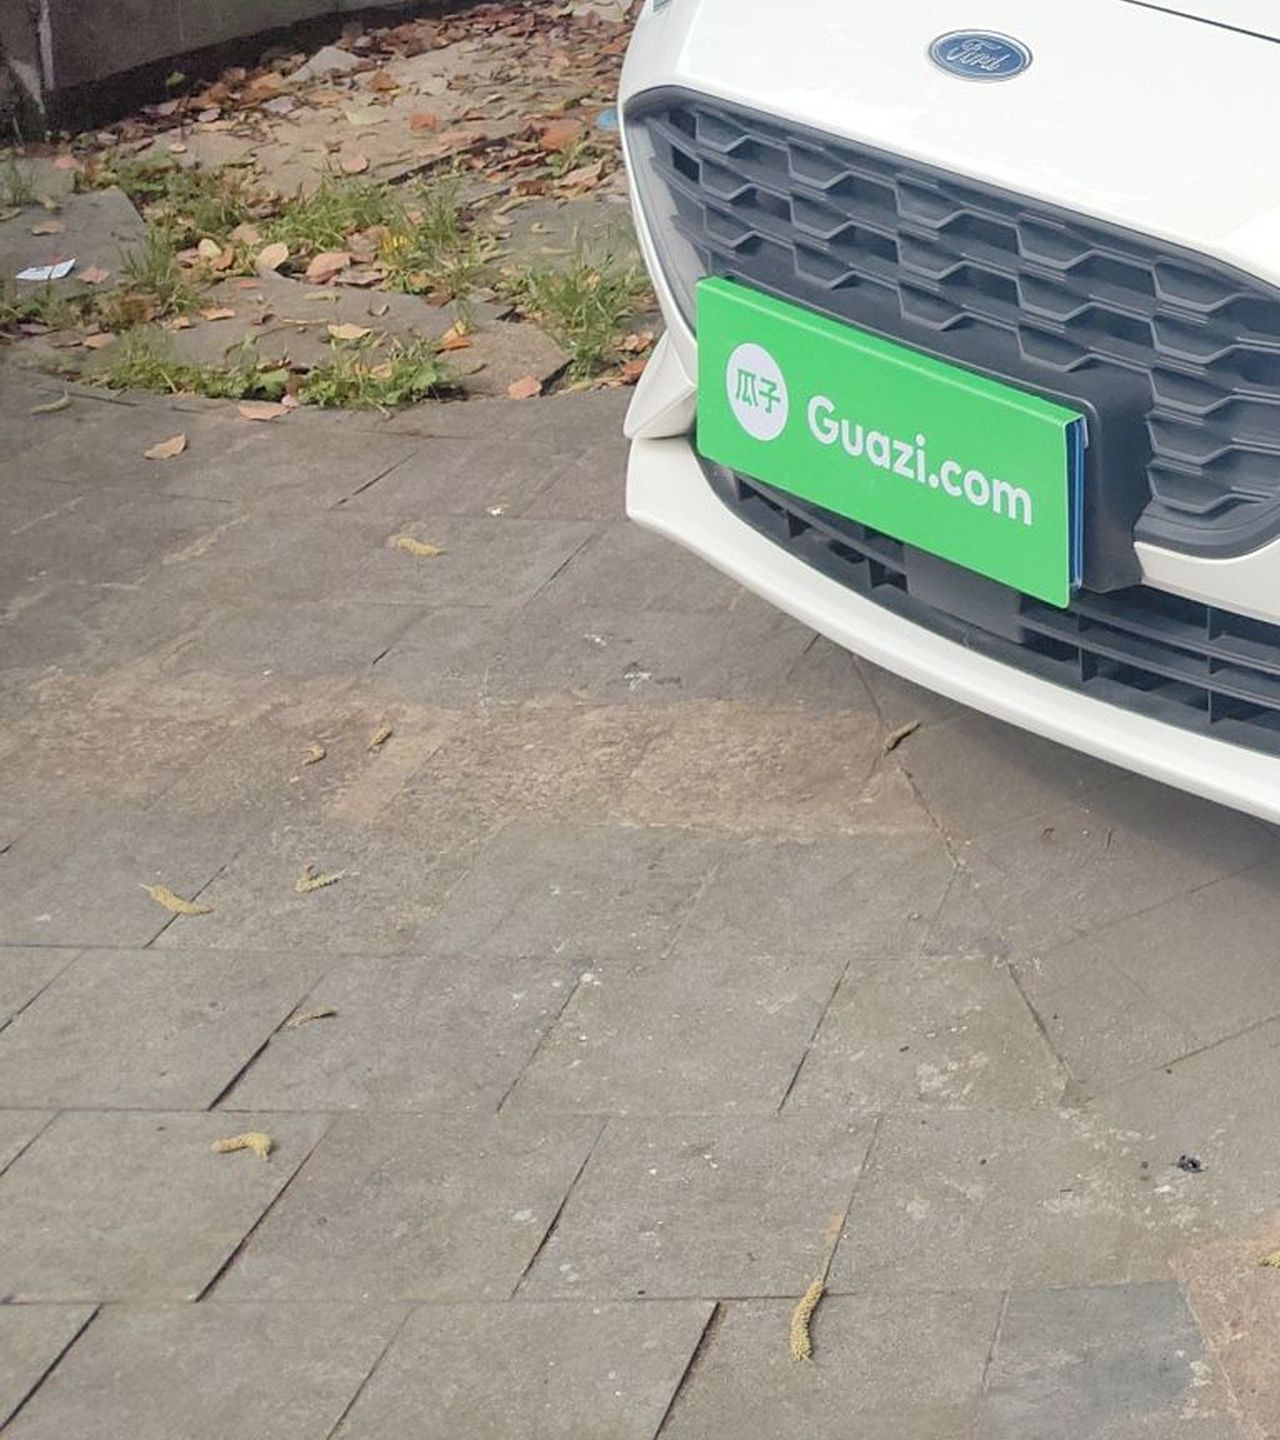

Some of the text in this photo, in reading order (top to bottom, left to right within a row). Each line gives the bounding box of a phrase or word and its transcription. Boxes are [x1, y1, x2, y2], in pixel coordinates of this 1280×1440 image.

[947, 40, 1010, 71] Ford
[735, 369, 781, 415] 瓜子
[807, 395, 1033, 527] Guazi.com
